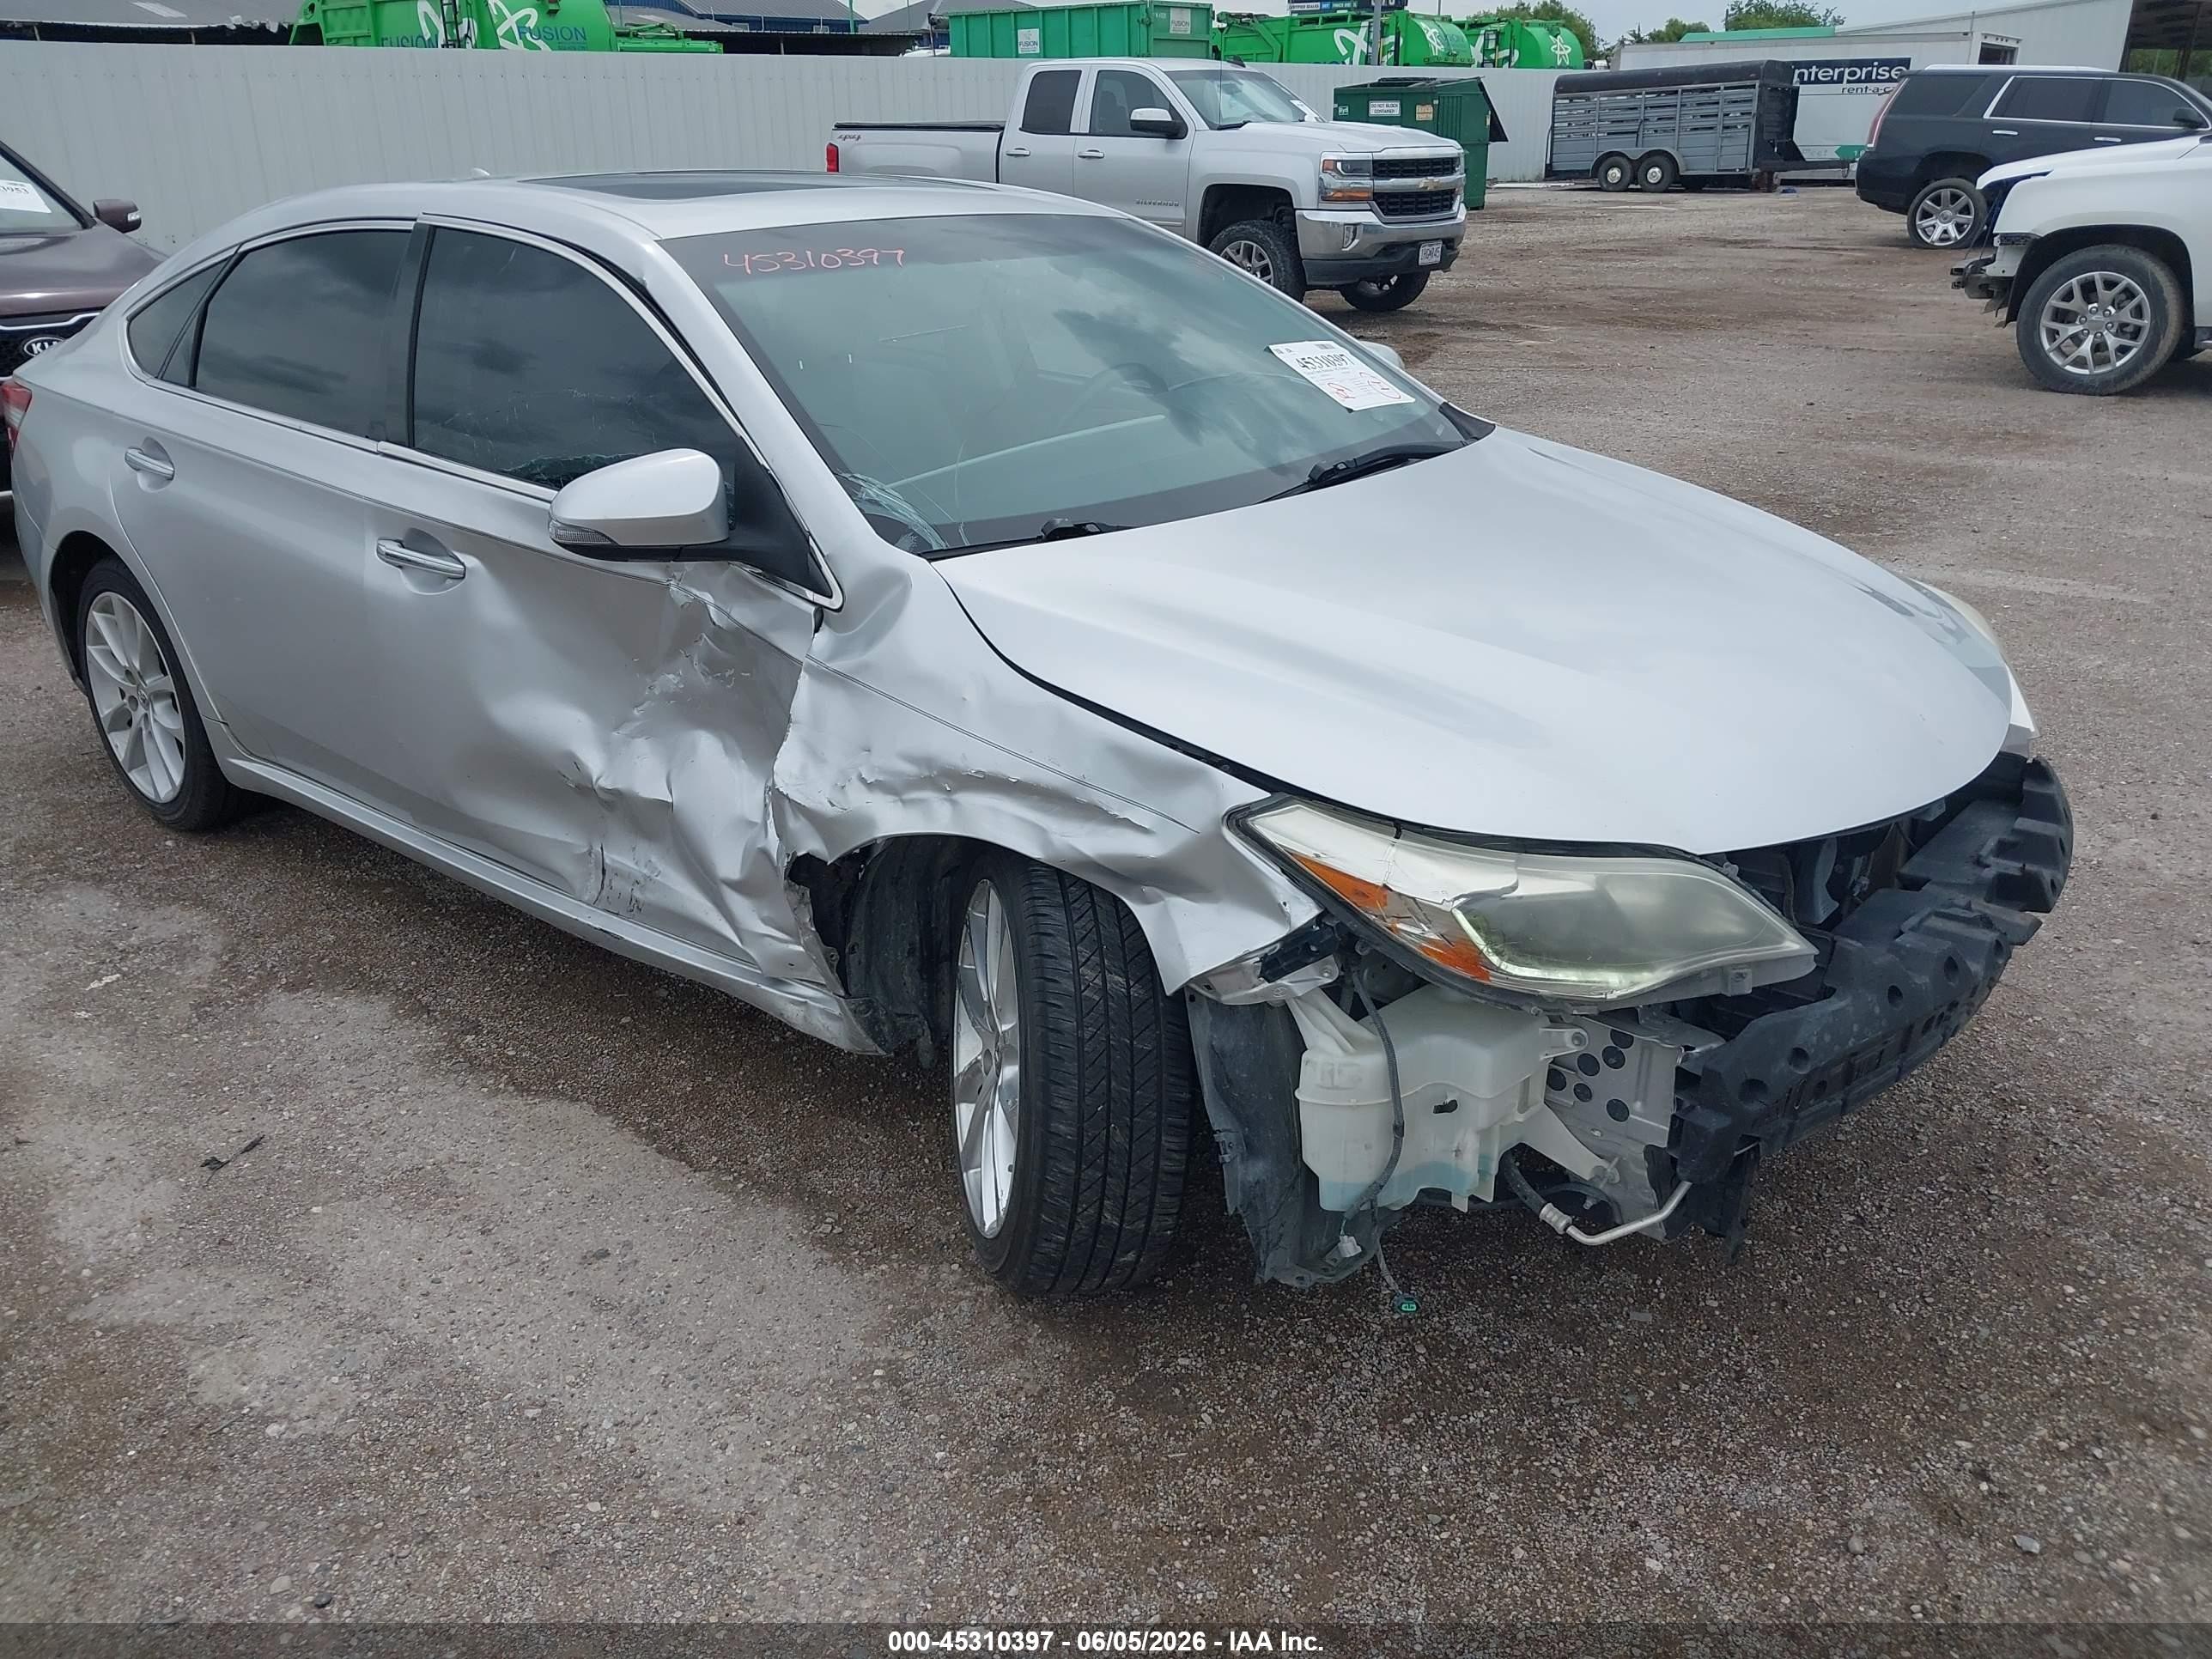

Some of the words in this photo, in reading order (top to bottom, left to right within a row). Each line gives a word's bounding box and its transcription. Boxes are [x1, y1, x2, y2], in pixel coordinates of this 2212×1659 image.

[381, 34, 439, 48] FUSION
[518, 26, 586, 41] FUSION
[1792, 62, 1908, 84] nterprise
[724, 248, 904, 275] 45310397
[31, 341, 58, 354] KI
[1296, 353, 1355, 371] 45310397
